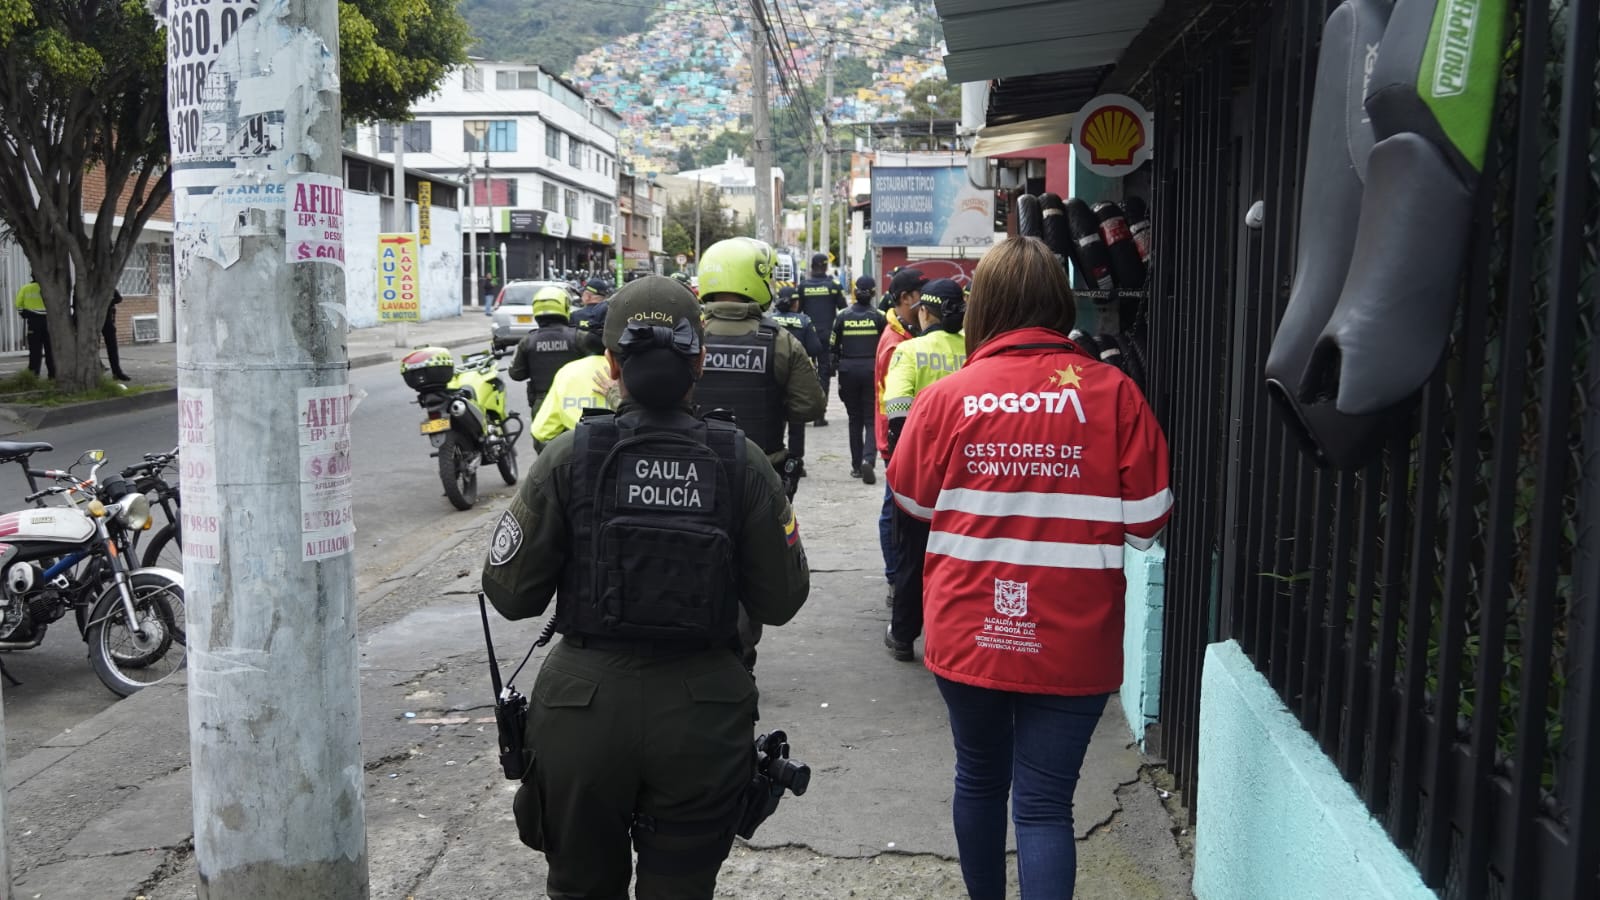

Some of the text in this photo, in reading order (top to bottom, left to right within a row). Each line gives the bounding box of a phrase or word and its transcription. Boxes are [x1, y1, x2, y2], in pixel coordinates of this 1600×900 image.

[298, 213, 316, 226] EPS
[383, 248, 396, 300] AUTO
[401, 247, 414, 300] LAVADO
[382, 302, 417, 310] LAVADO
[964, 443, 1082, 459] GESTORES DE
[635, 459, 699, 481] GAULA
[966, 461, 1080, 478] CONVIVENCIA
[628, 480, 702, 508] POLICÍA
[191, 515, 218, 532] 9848
[984, 617, 1036, 629] ALCALDÍA MAYOR
